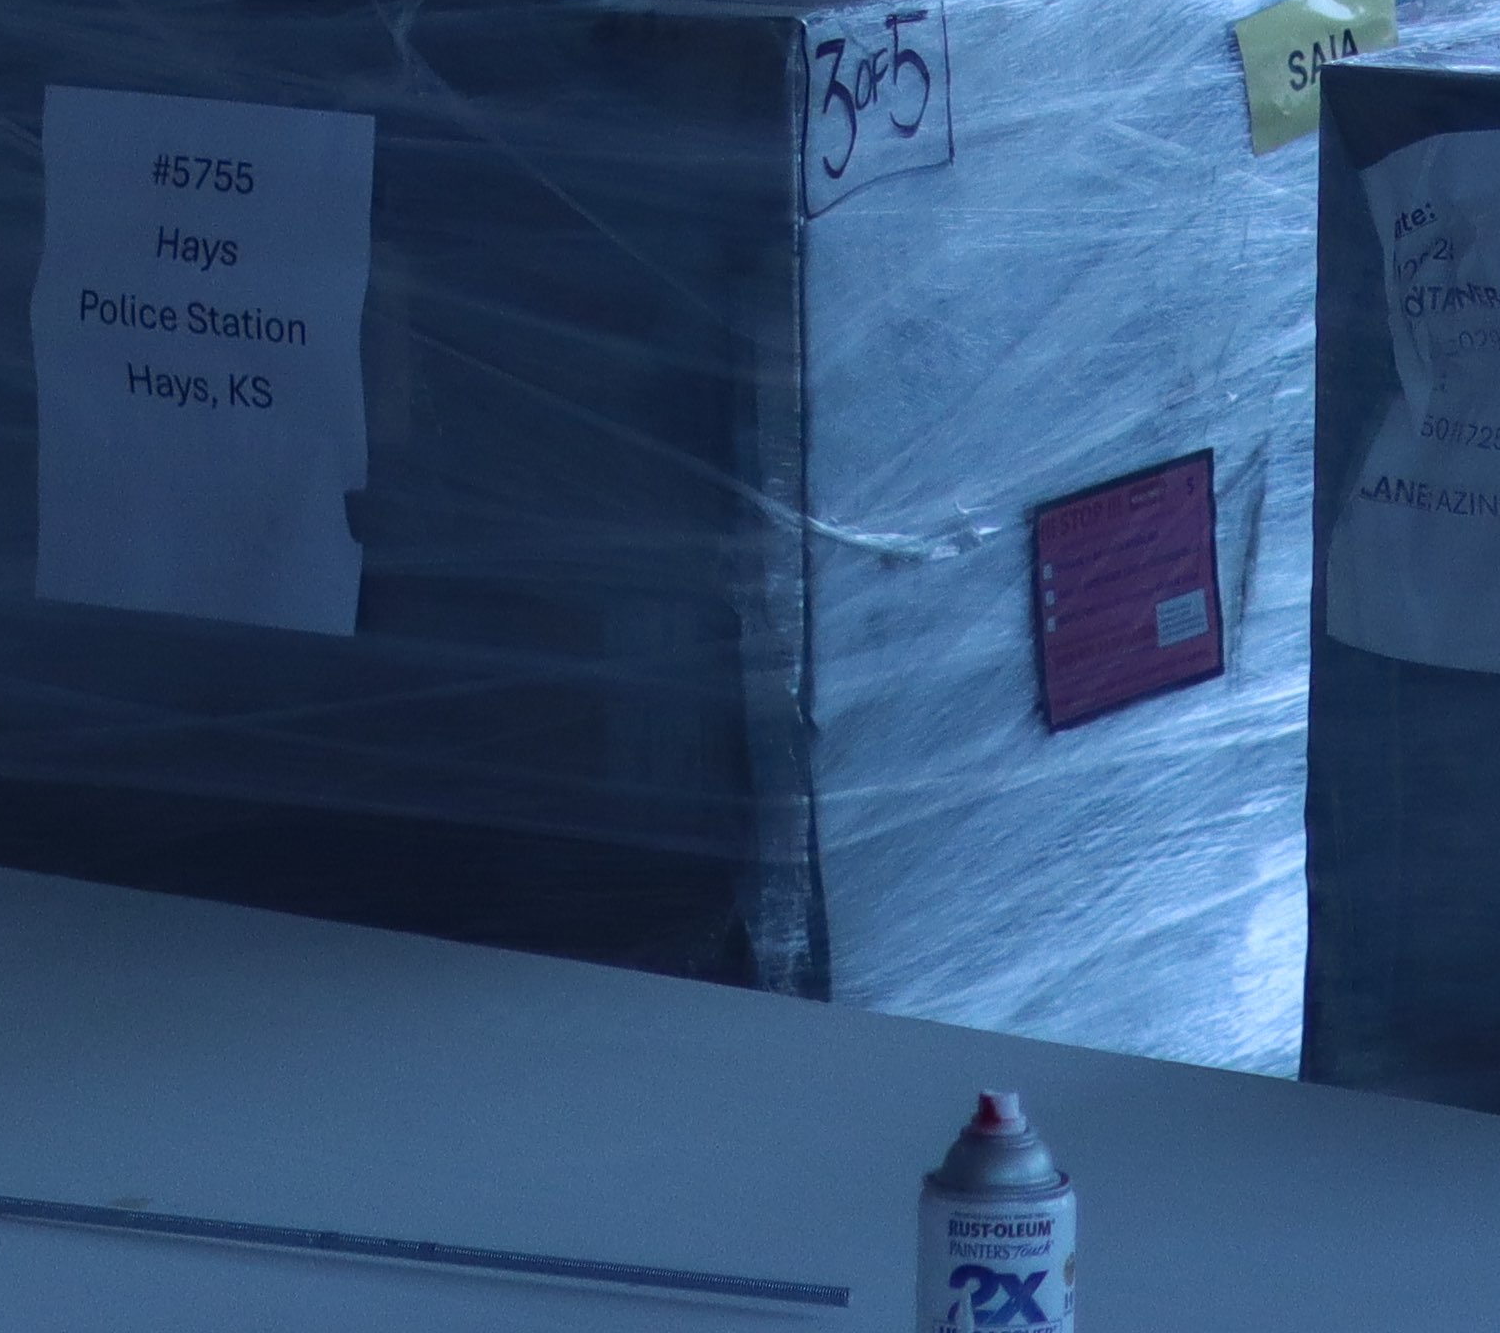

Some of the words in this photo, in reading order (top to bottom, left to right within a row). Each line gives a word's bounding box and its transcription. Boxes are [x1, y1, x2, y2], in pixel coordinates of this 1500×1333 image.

[1288, 28, 1361, 92] SAIA
[815, 38, 858, 179] 3
[885, 9, 931, 139] 5
[152, 153, 255, 196] #5755
[155, 224, 239, 272] Hays
[79, 287, 178, 332] Police
[186, 301, 307, 347] Station
[127, 361, 219, 410] Hays,
[228, 372, 274, 410] KS
[947, 1218, 1054, 1239] RUST-OLEUM
[948, 1264, 1049, 1325] 2X
